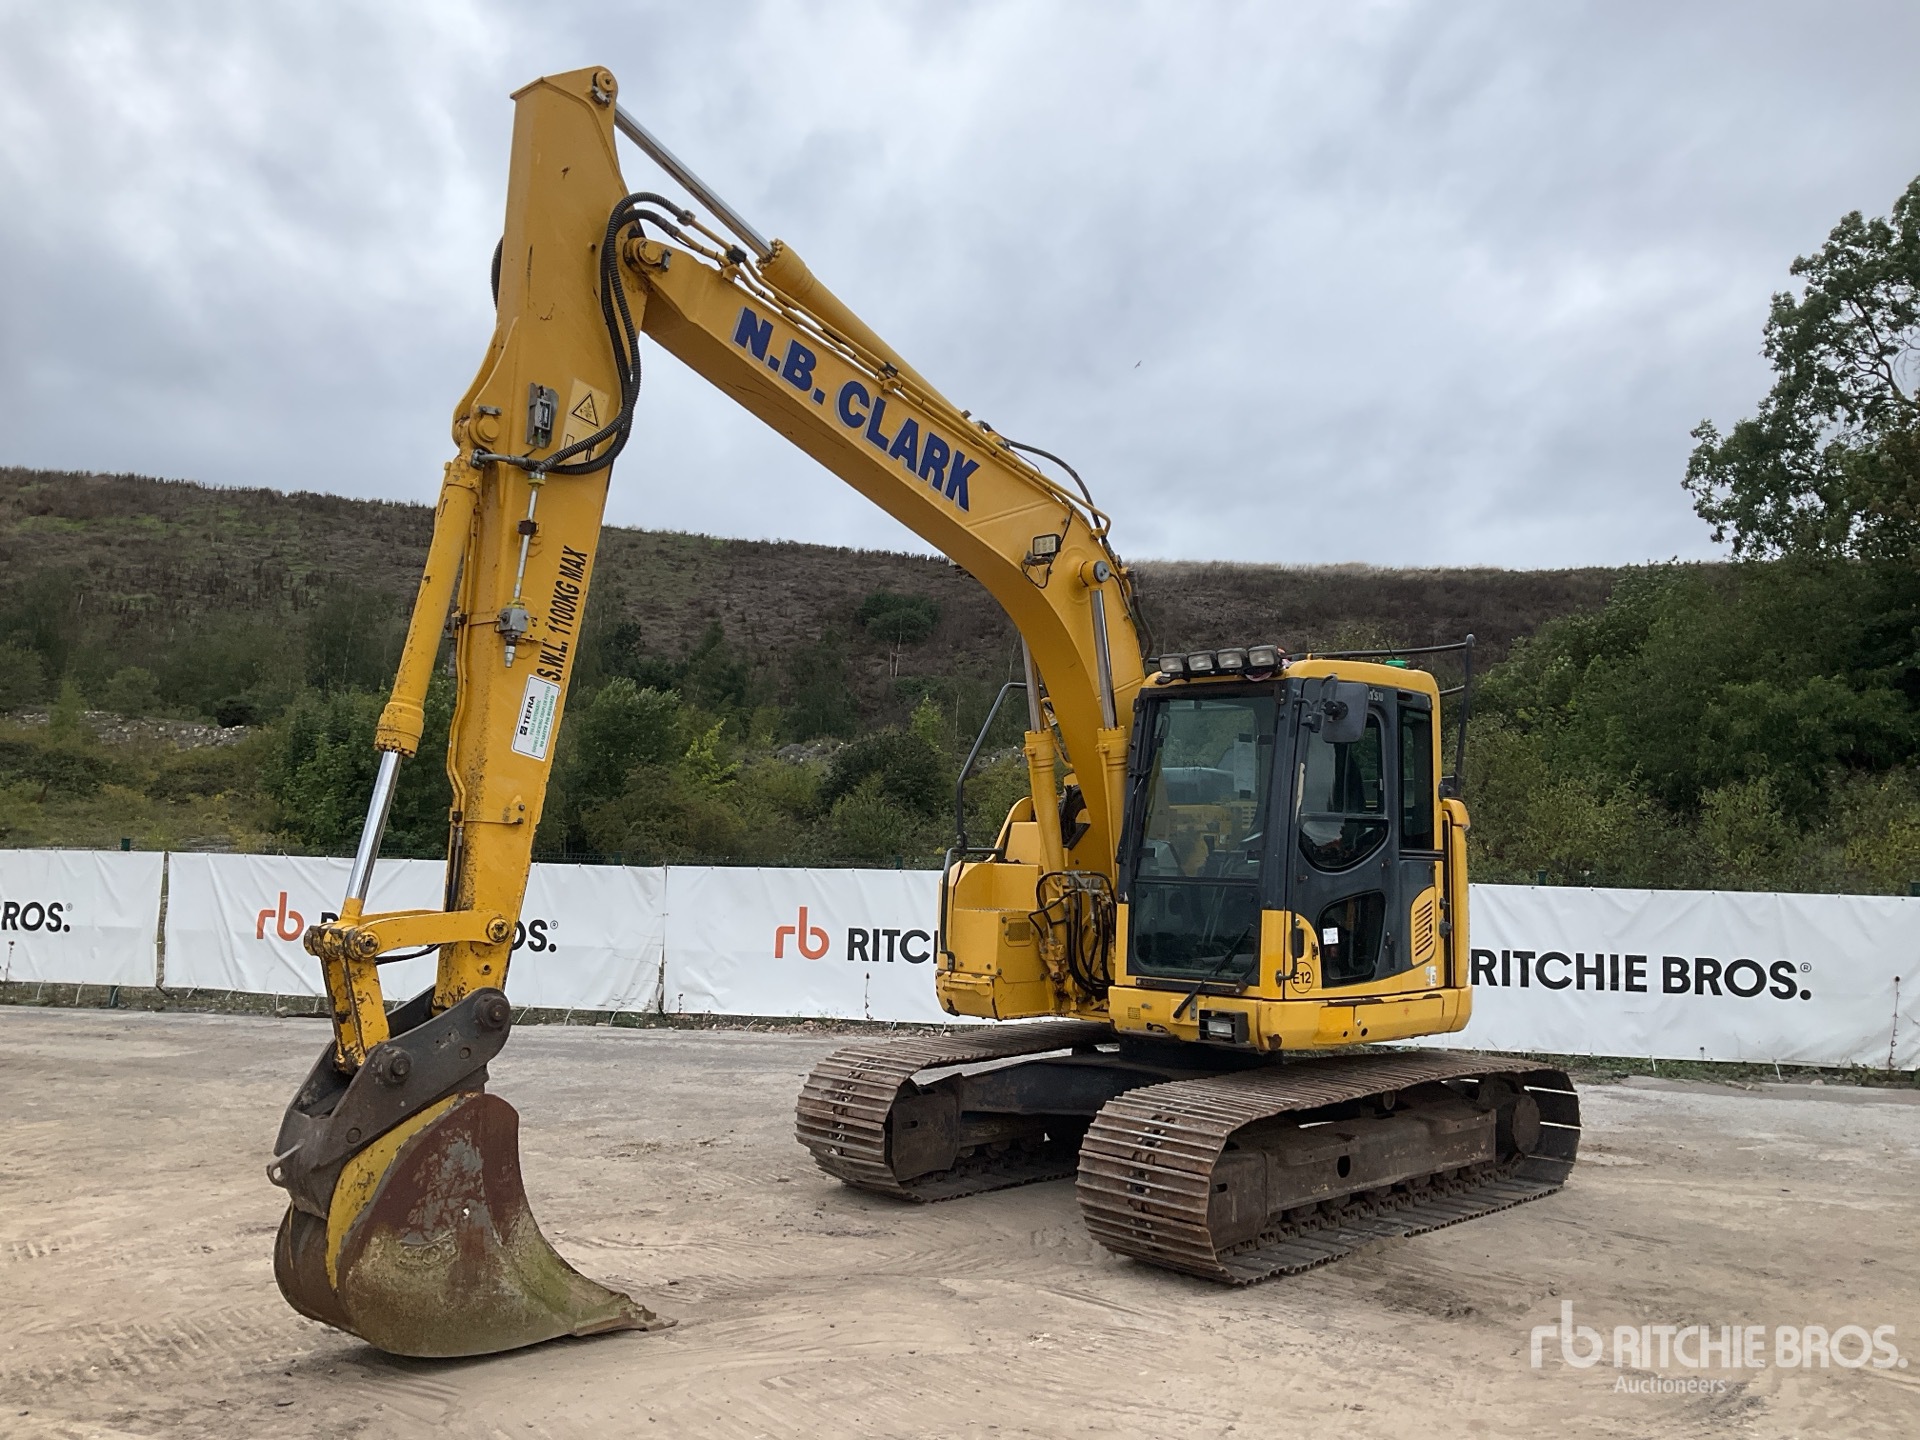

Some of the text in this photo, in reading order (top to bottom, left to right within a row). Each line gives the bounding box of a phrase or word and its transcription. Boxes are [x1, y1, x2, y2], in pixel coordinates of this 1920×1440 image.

[733, 307, 980, 512] N.B. CLARK
[558, 544, 588, 583] MAX
[547, 580, 580, 635] 1100KG
[523, 696, 535, 724] TEFRA
[0, 901, 71, 933] ROS.
[256, 892, 304, 941] rb
[774, 906, 830, 960] rb
[1293, 971, 1312, 985] E12
[1470, 949, 1648, 992] RITCHIE
